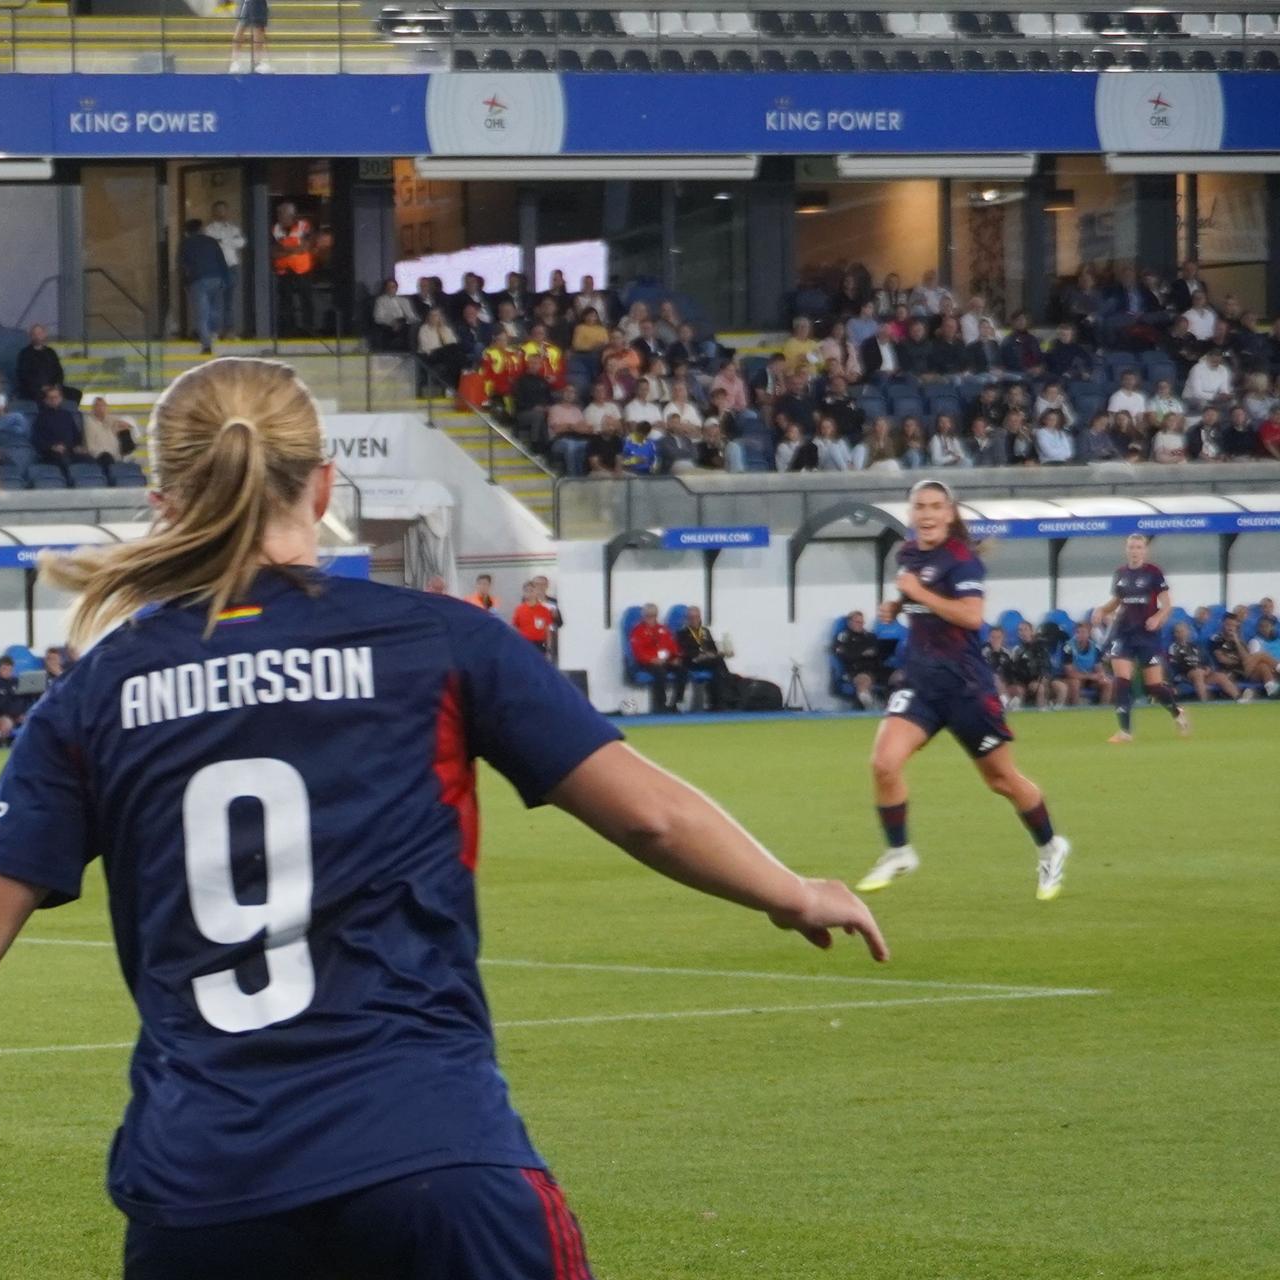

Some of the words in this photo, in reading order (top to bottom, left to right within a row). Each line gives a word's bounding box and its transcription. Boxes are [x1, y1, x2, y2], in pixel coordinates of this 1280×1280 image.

[69, 112, 130, 133] KING
[135, 112, 217, 133] POWER
[484, 118, 506, 129] OHL
[765, 111, 822, 131] KING
[827, 111, 902, 131] POWER
[1037, 520, 1107, 532] OHLEUVEN.COM
[1137, 517, 1206, 529] OHLEUVEN.COM
[680, 533, 750, 544] OHLEUVEN.COM
[120, 646, 376, 729] ANDERSSON
[182, 757, 316, 1033] 9
